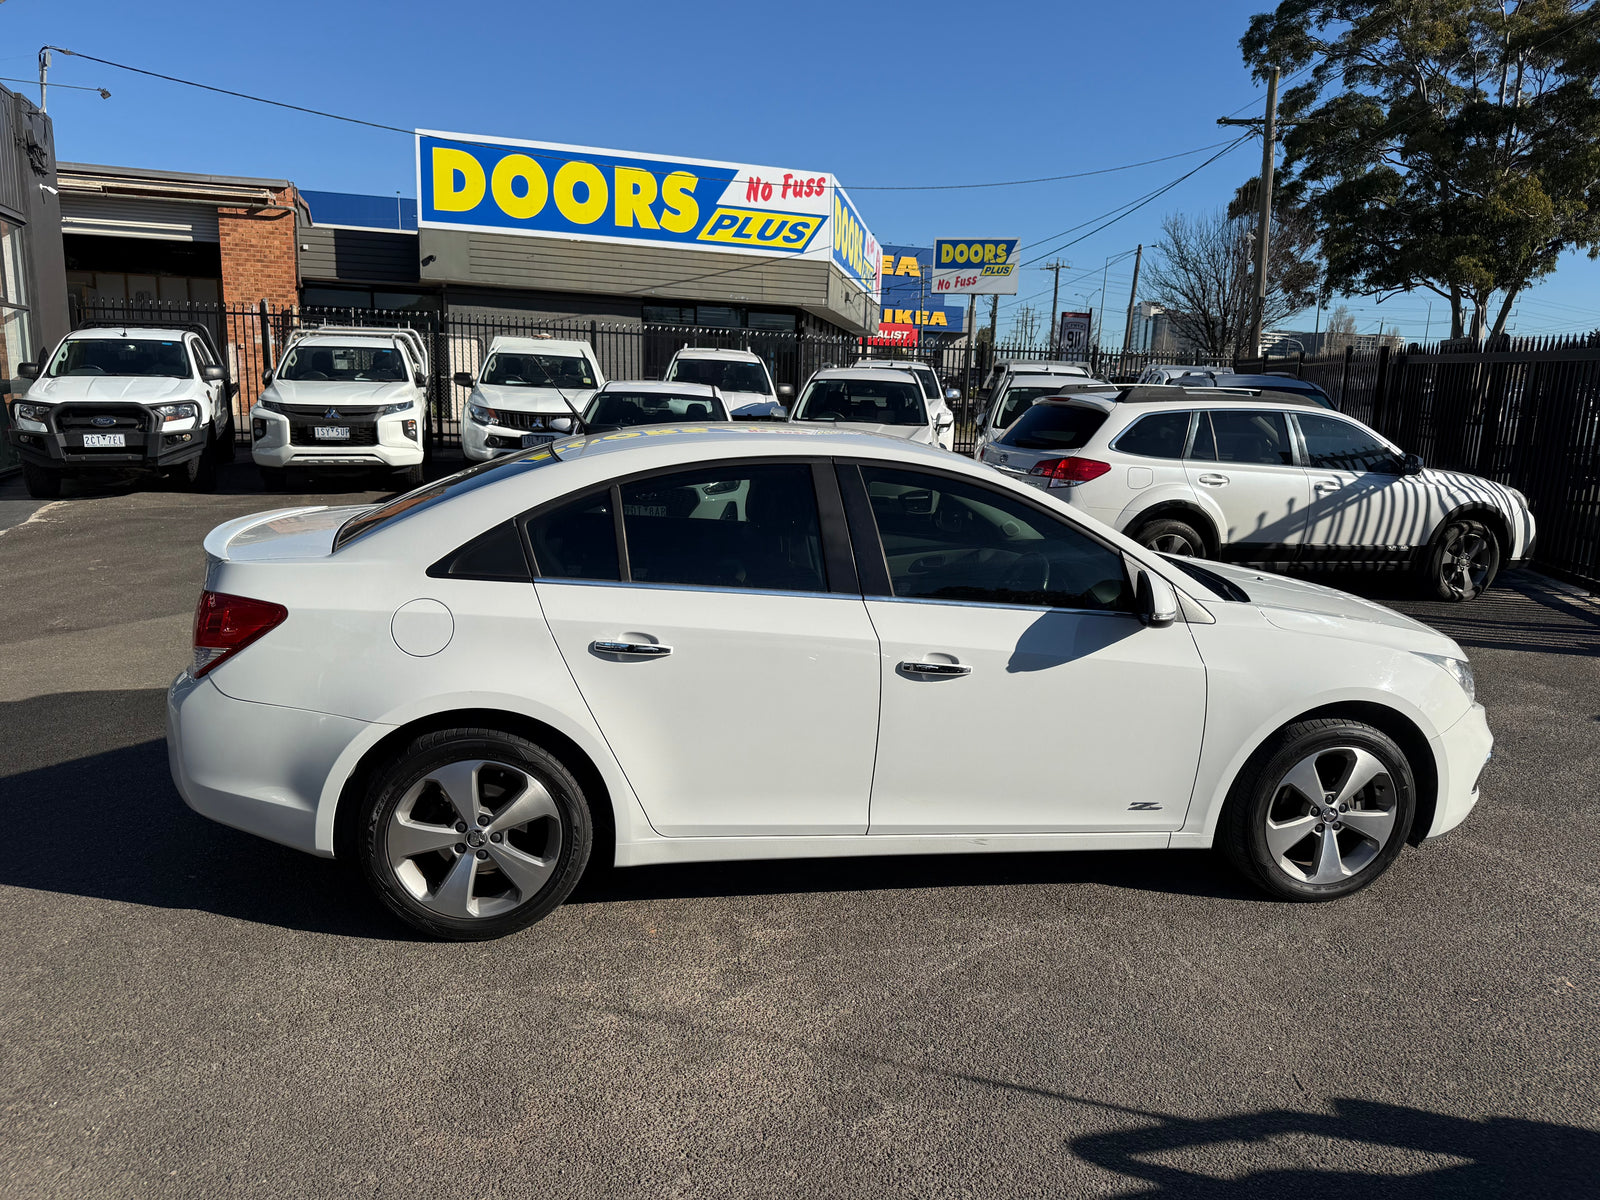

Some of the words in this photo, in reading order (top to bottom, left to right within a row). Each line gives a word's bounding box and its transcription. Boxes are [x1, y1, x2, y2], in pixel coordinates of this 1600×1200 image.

[433, 147, 699, 233] DOORS
[746, 176, 773, 202] No
[781, 173, 826, 200] Fuss
[706, 214, 811, 244] PLUS
[834, 194, 864, 276] DOORS
[941, 243, 1007, 264] DOORS
[984, 266, 1010, 274] PLUS
[937, 278, 951, 291] No
[954, 275, 978, 288] Fuss
[883, 308, 948, 326] IKEA
